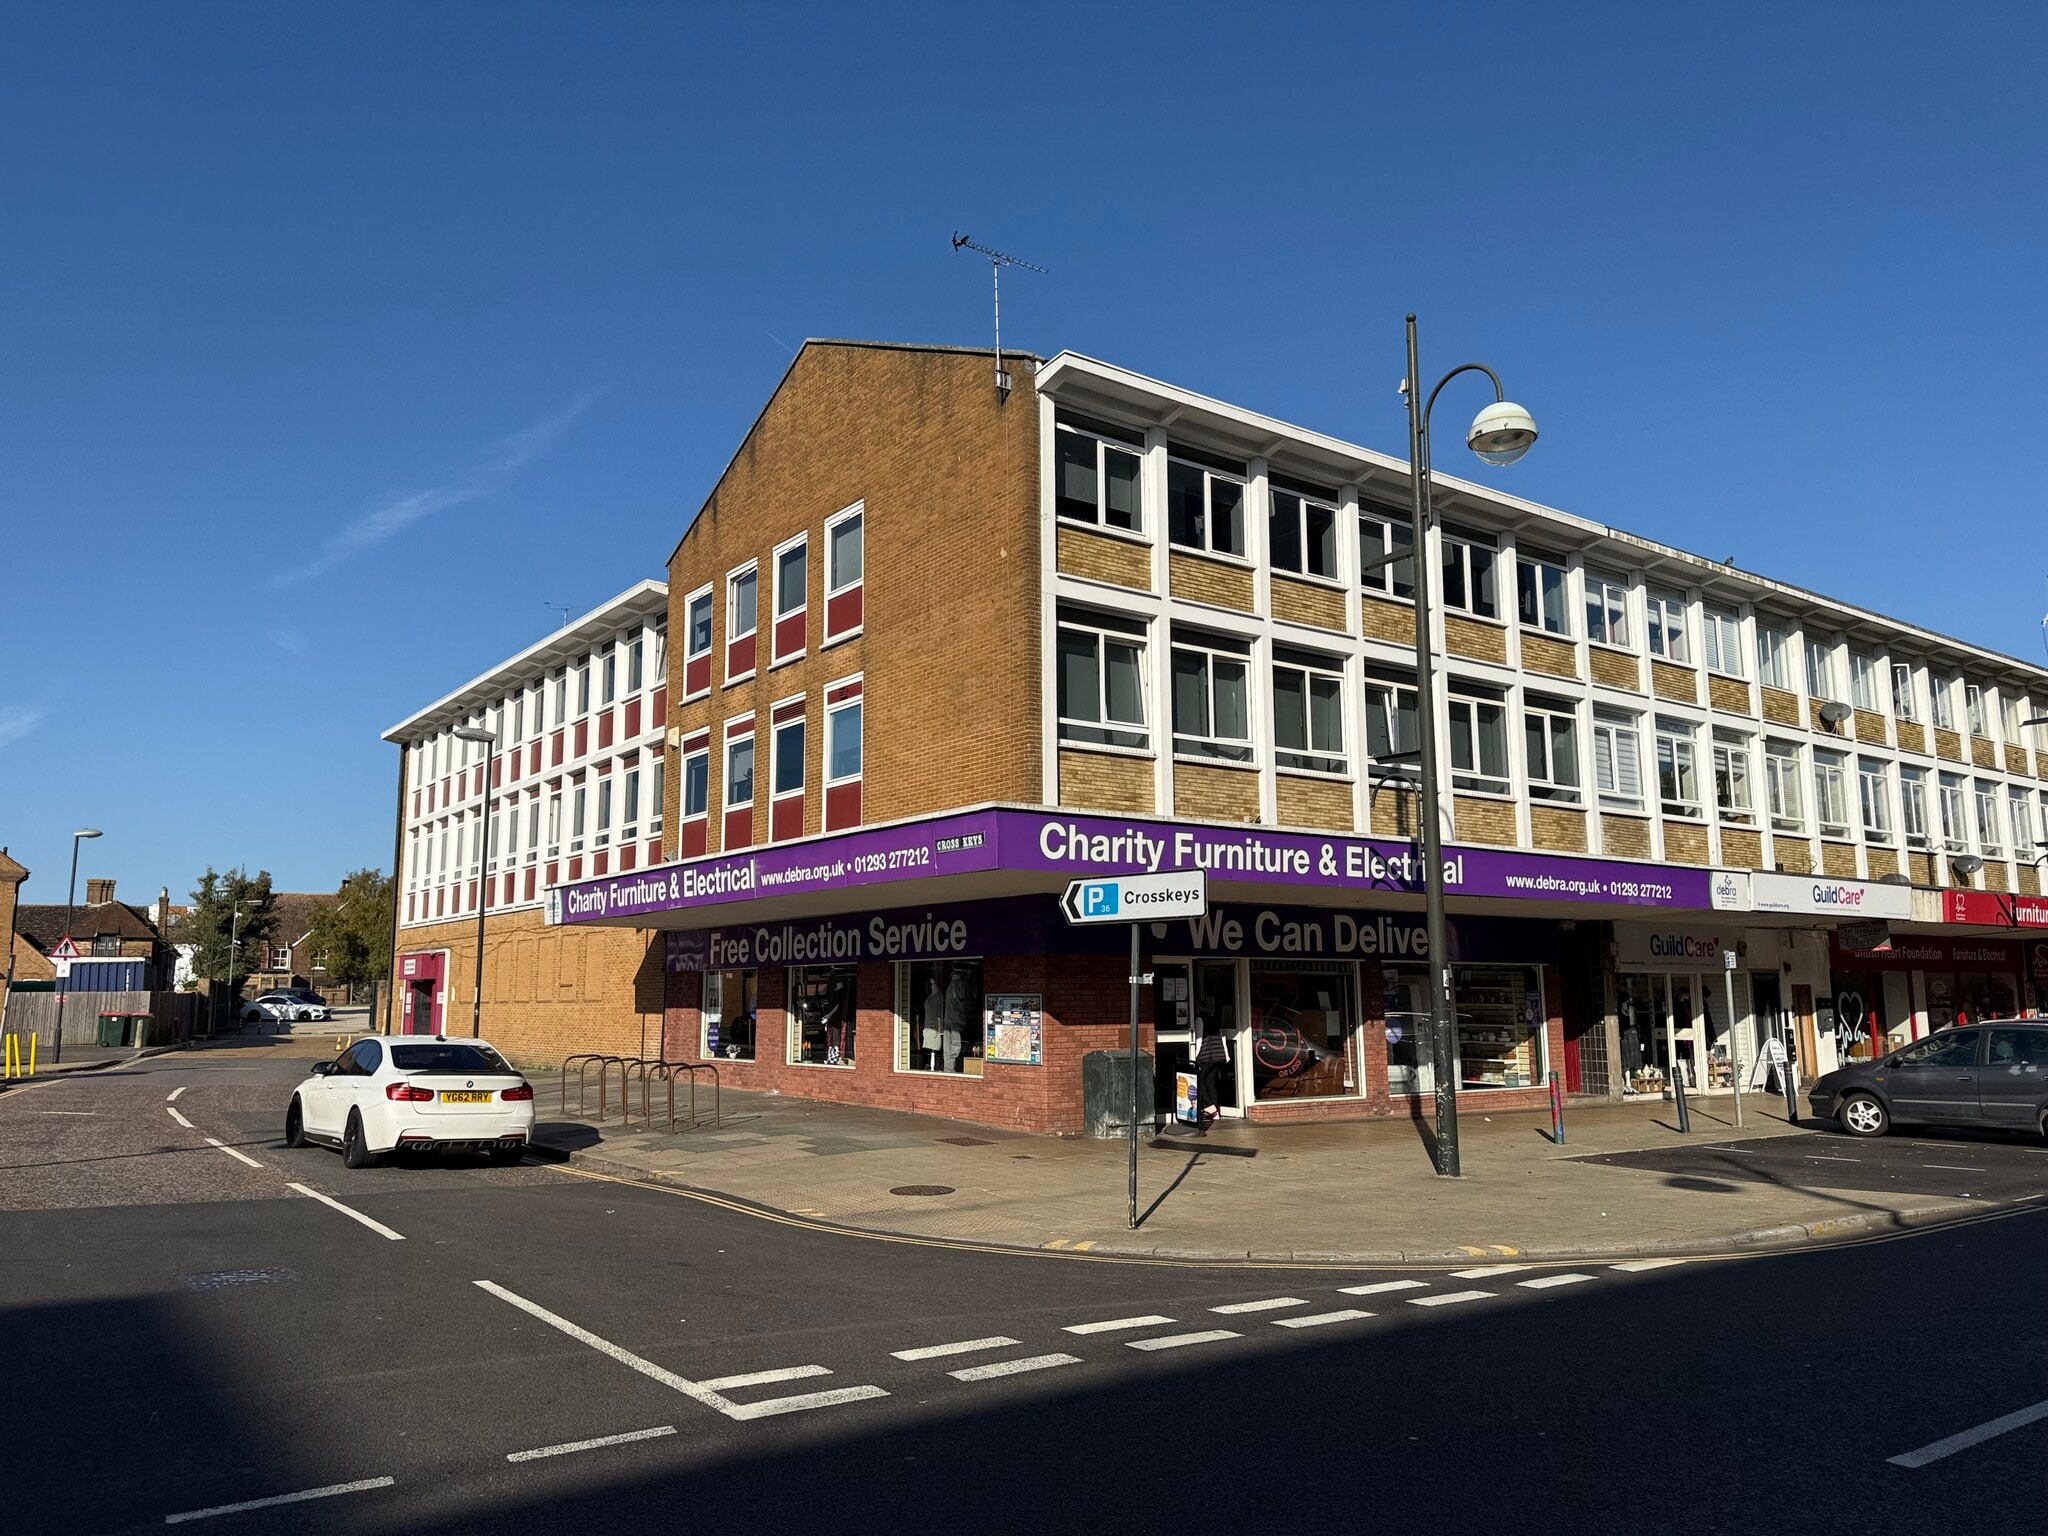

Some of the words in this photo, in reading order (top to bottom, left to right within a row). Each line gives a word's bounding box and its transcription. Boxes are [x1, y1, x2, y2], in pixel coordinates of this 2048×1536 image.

[937, 839, 960, 851] CROSS
[962, 834, 983, 847] KEYS
[1039, 821, 1165, 872] Charity
[1174, 832, 1310, 874] Furniture
[1318, 843, 1338, 876] &
[1346, 846, 1463, 884] Electrial
[761, 859, 845, 887] www.debra.org.uk
[854, 852, 887, 874] 01293
[888, 846, 930, 867] 277212
[568, 886, 608, 915] Charity
[609, 879, 667, 908] Furniture
[669, 872, 681, 899] &
[683, 860, 755, 897] Electrical
[1124, 888, 1200, 905] Crosskeys
[1506, 875, 1601, 896] www.debra.org.uk
[1610, 881, 1639, 897] 01293
[1640, 884, 1672, 899] 277212
[1716, 884, 1737, 896] debra
[1812, 884, 1861, 906] GuildCare
[1088, 887, 1104, 913] P
[1100, 904, 1111, 913] 36
[710, 933, 750, 965] Free
[755, 922, 861, 963] Collection
[868, 912, 967, 956] Service
[1188, 910, 1244, 950] We
[1255, 910, 1323, 952] Can
[1334, 914, 1428, 955] Delive
[1650, 934, 1716, 958] GuildCare
[1902, 945, 1943, 961] Foundation
[1952, 947, 1977, 961] Furniture
[1977, 949, 1983, 961] &
[1983, 949, 2006, 962] Electrical
[1278, 1069, 1289, 1077] OR
[446, 1093, 470, 1102] YG62
[471, 1093, 489, 1102] RRY
